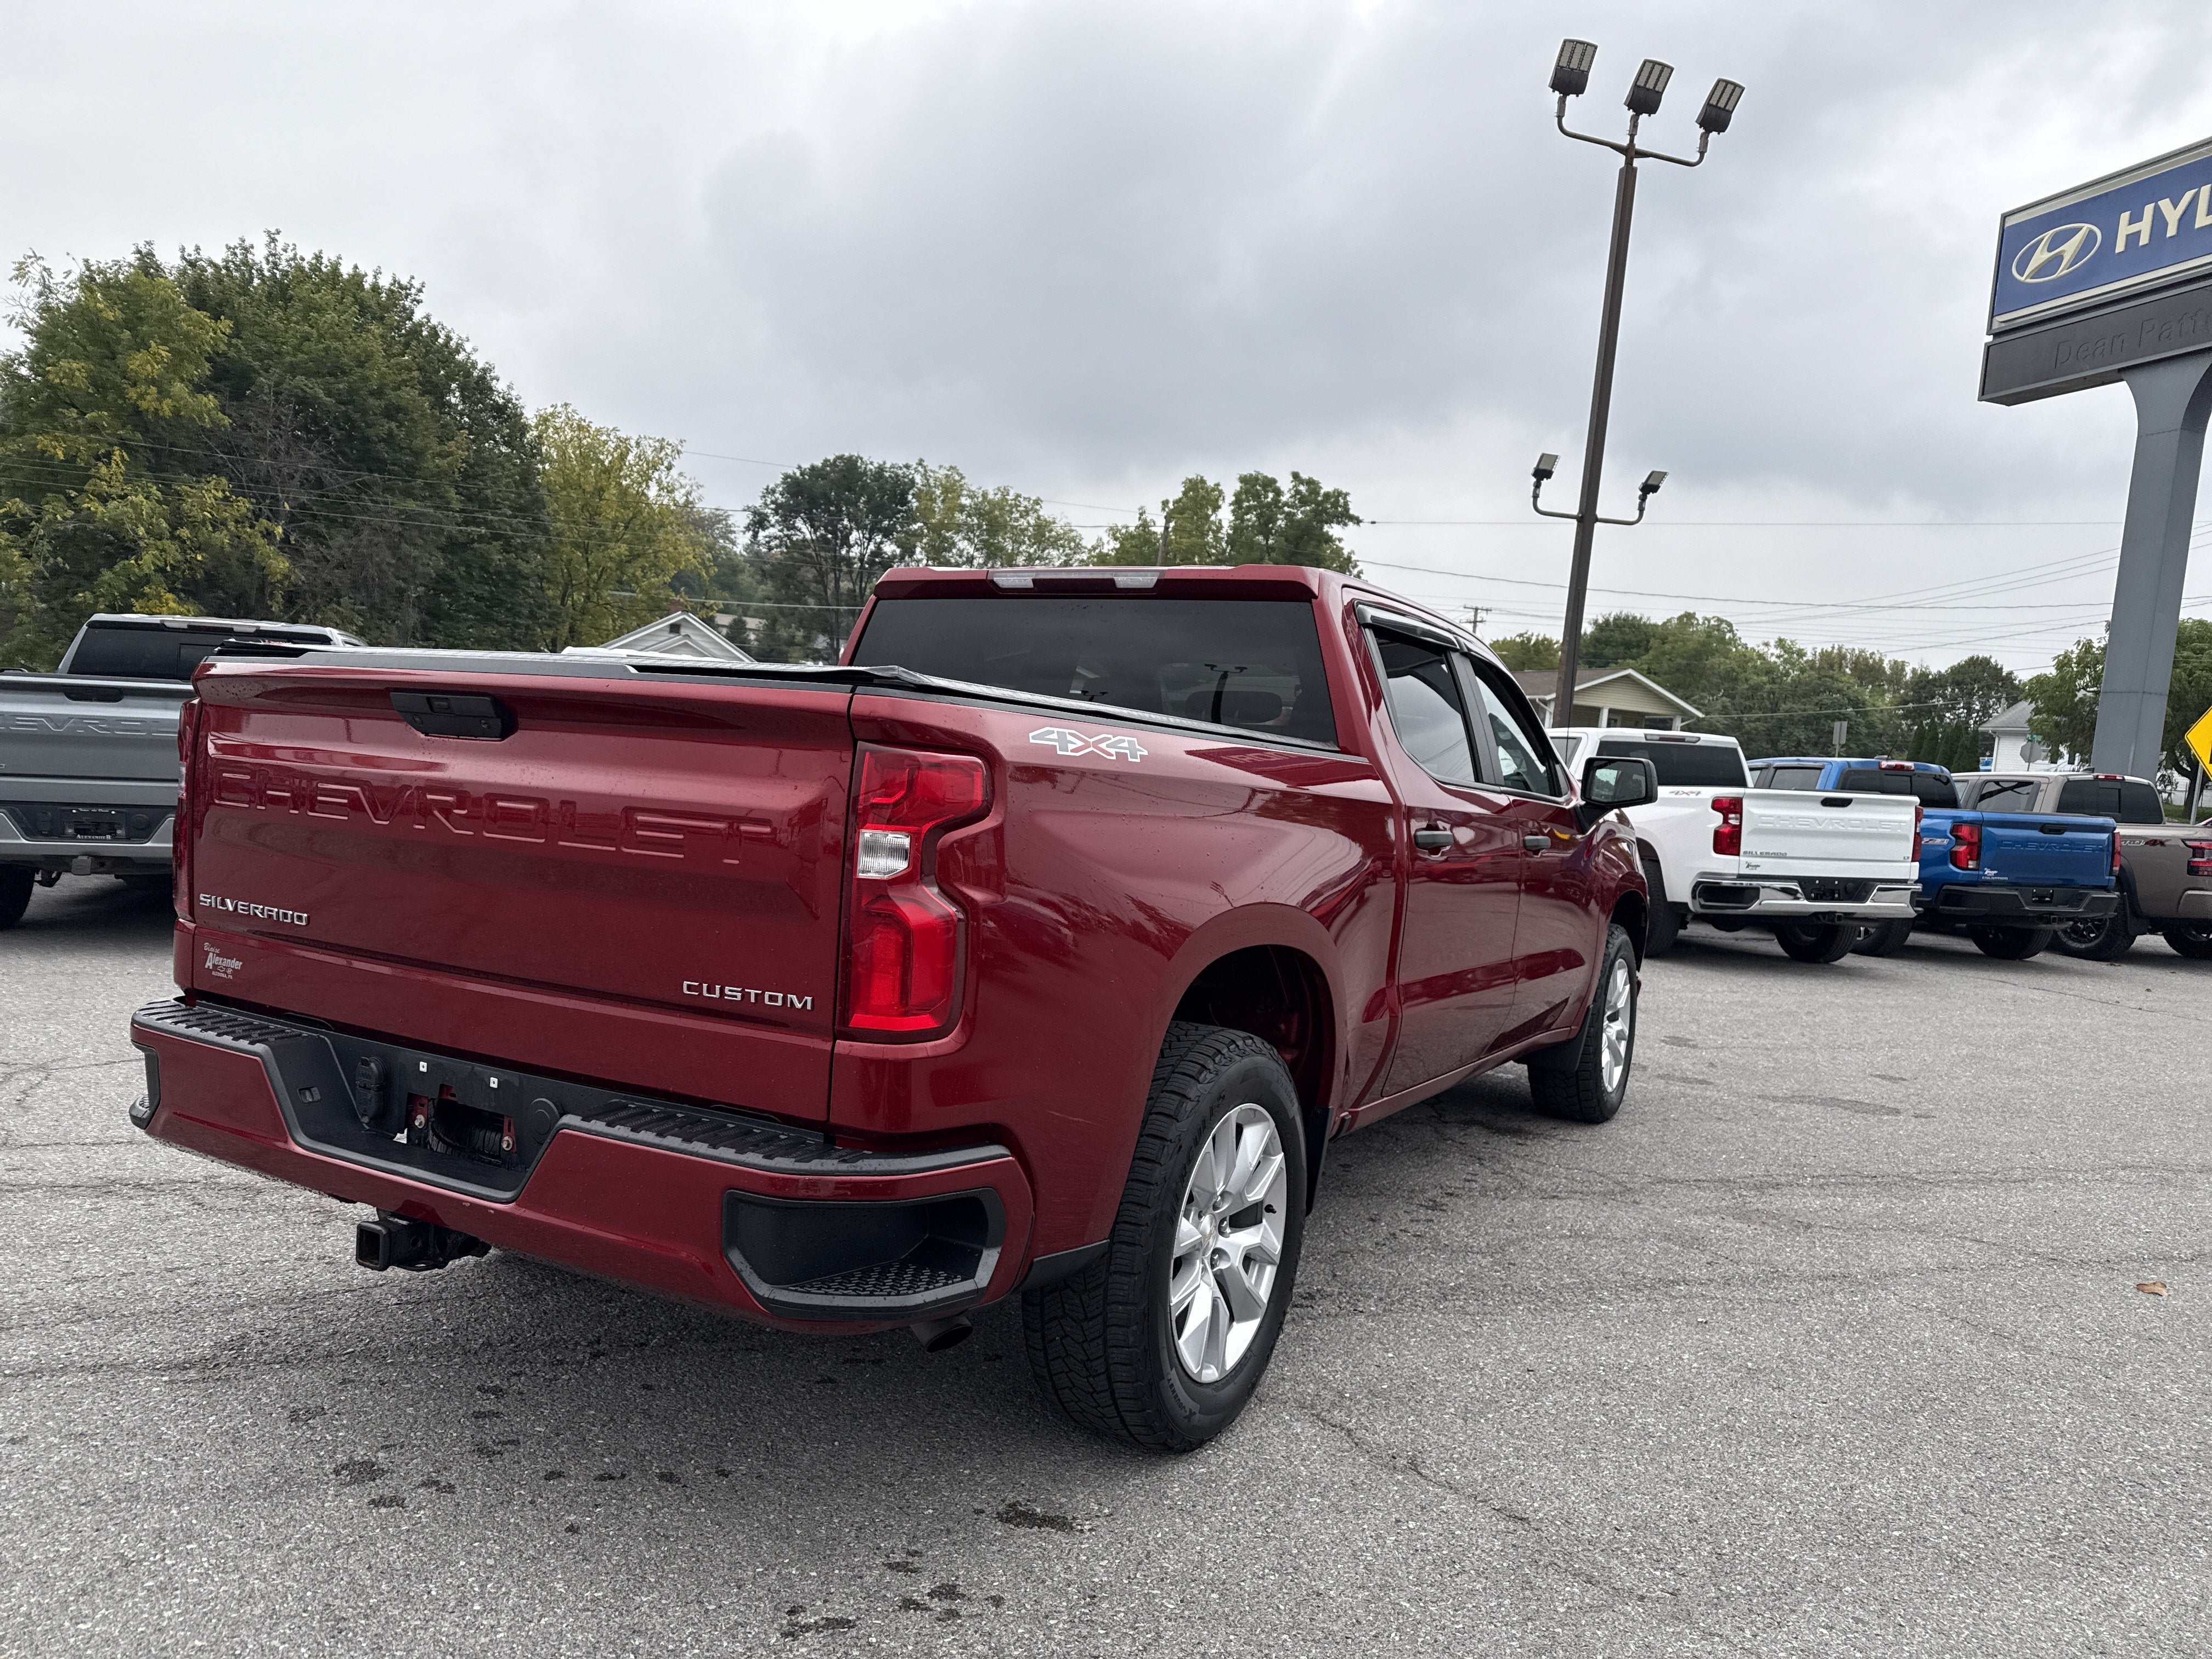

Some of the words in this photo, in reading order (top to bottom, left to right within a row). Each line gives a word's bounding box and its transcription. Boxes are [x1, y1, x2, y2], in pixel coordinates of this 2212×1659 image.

[2055, 332, 2125, 369] Dean
[213, 765, 772, 865] CHEVROLET
[1757, 815, 1906, 832] CHEVROLET
[2000, 841, 2104, 853] CHEVROLET
[199, 894, 309, 926] SILVERADO
[205, 952, 242, 970] Alexander
[683, 981, 813, 1010] CUSTOM
